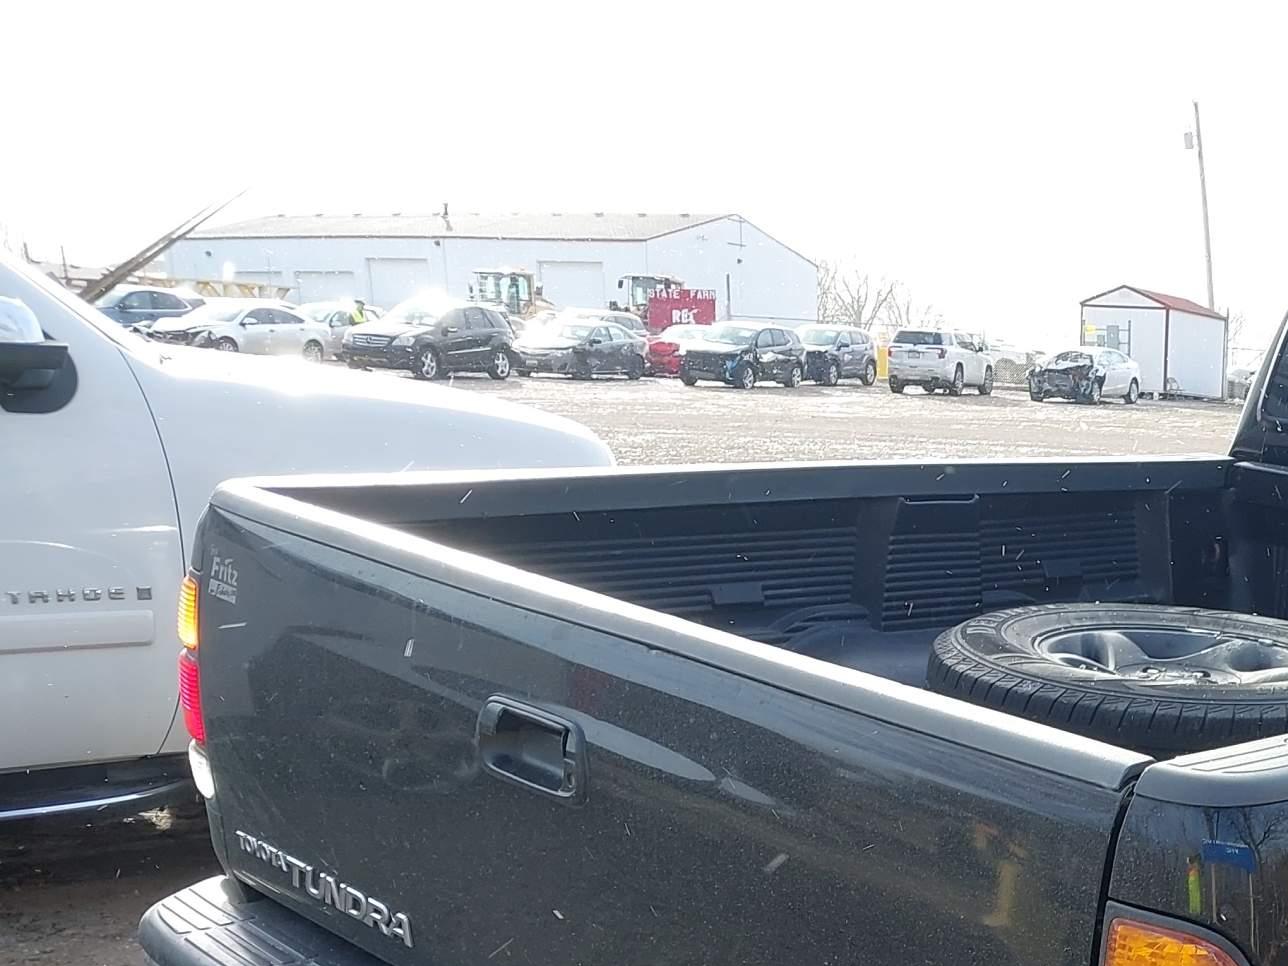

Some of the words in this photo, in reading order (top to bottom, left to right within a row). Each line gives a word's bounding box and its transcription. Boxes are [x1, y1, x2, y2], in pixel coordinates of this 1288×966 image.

[648, 287, 681, 299] STATE
[211, 556, 238, 586] Fritz
[6, 586, 125, 604] TAHOE
[235, 830, 288, 873] TOYOTA
[286, 855, 415, 948] TUNDRA
